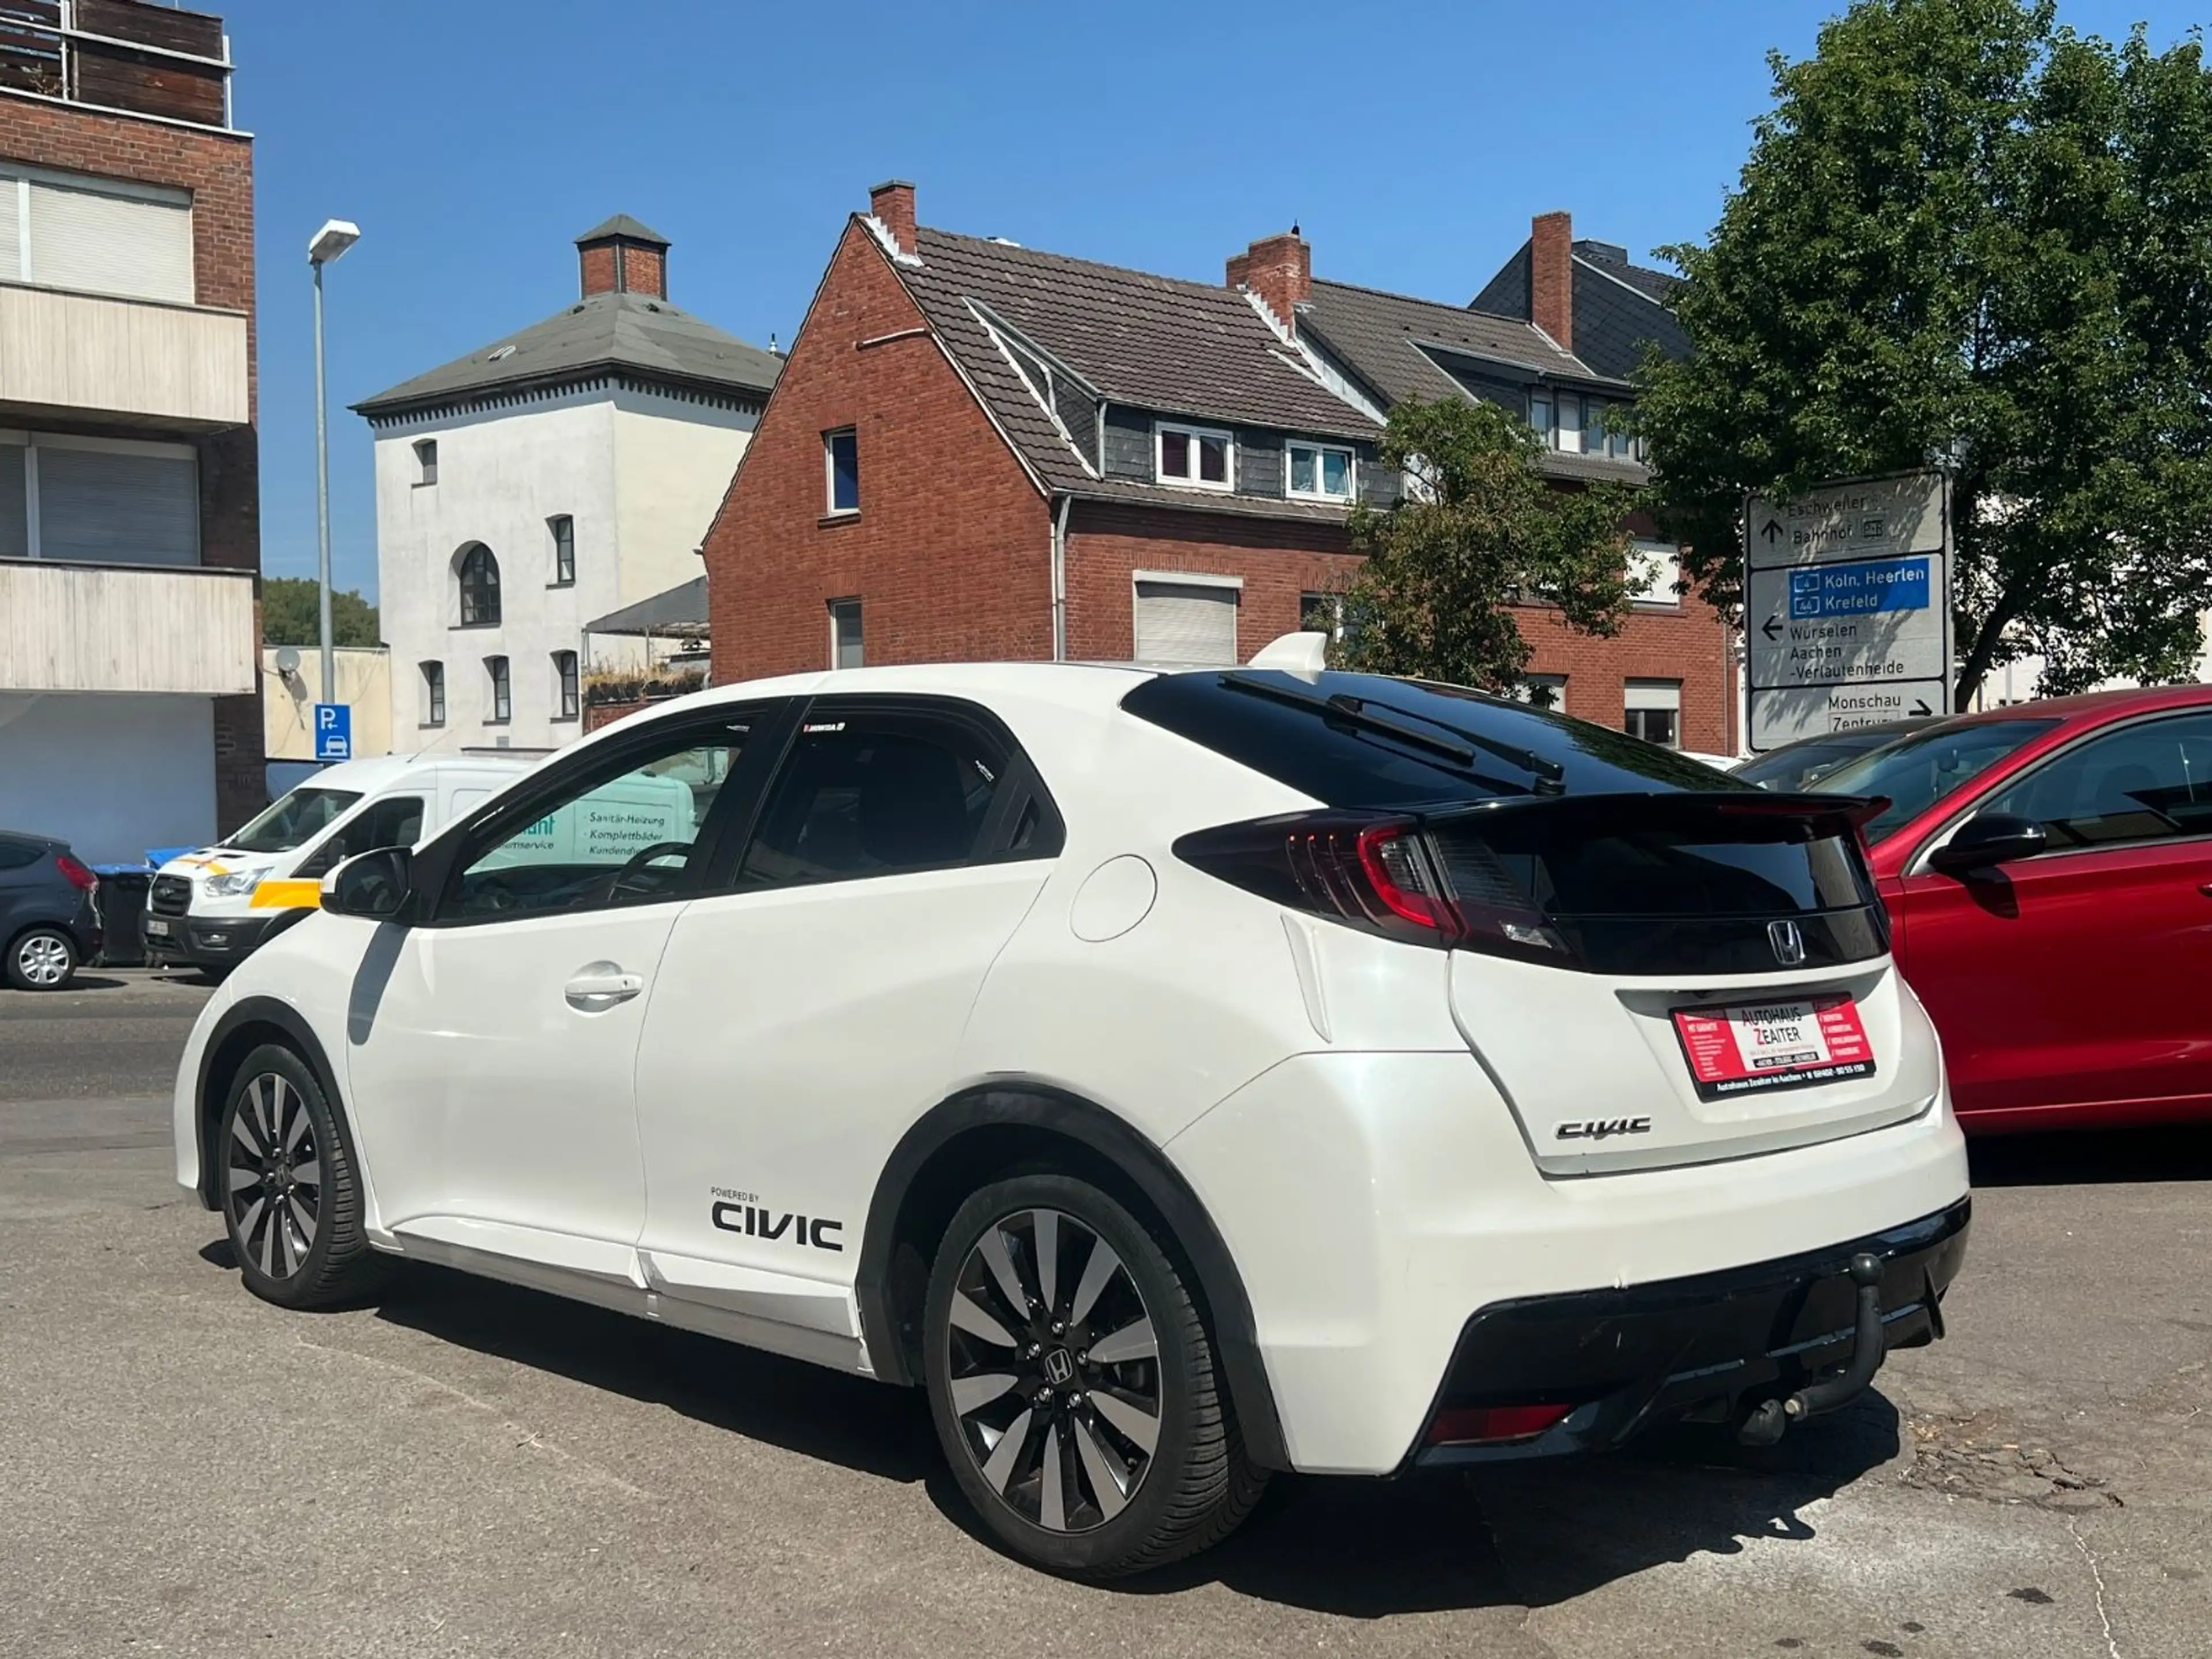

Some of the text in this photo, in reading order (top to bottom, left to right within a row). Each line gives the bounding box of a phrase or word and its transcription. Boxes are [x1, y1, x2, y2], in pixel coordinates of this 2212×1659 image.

[1794, 524, 1853, 544] Bahnhof
[1866, 567, 1924, 585] Heerlen
[1825, 594, 1877, 610] Krefeld
[1790, 646, 1842, 660] Aachen
[1828, 692, 1900, 710] Monschau
[1742, 1006, 1802, 1027] AUTOHAUS
[1753, 1027, 1802, 1046] ZEAITER
[1556, 1116, 1651, 1140] CIVIC
[710, 1186, 759, 1203] POWERED BY
[711, 1200, 843, 1252] CIVIC
